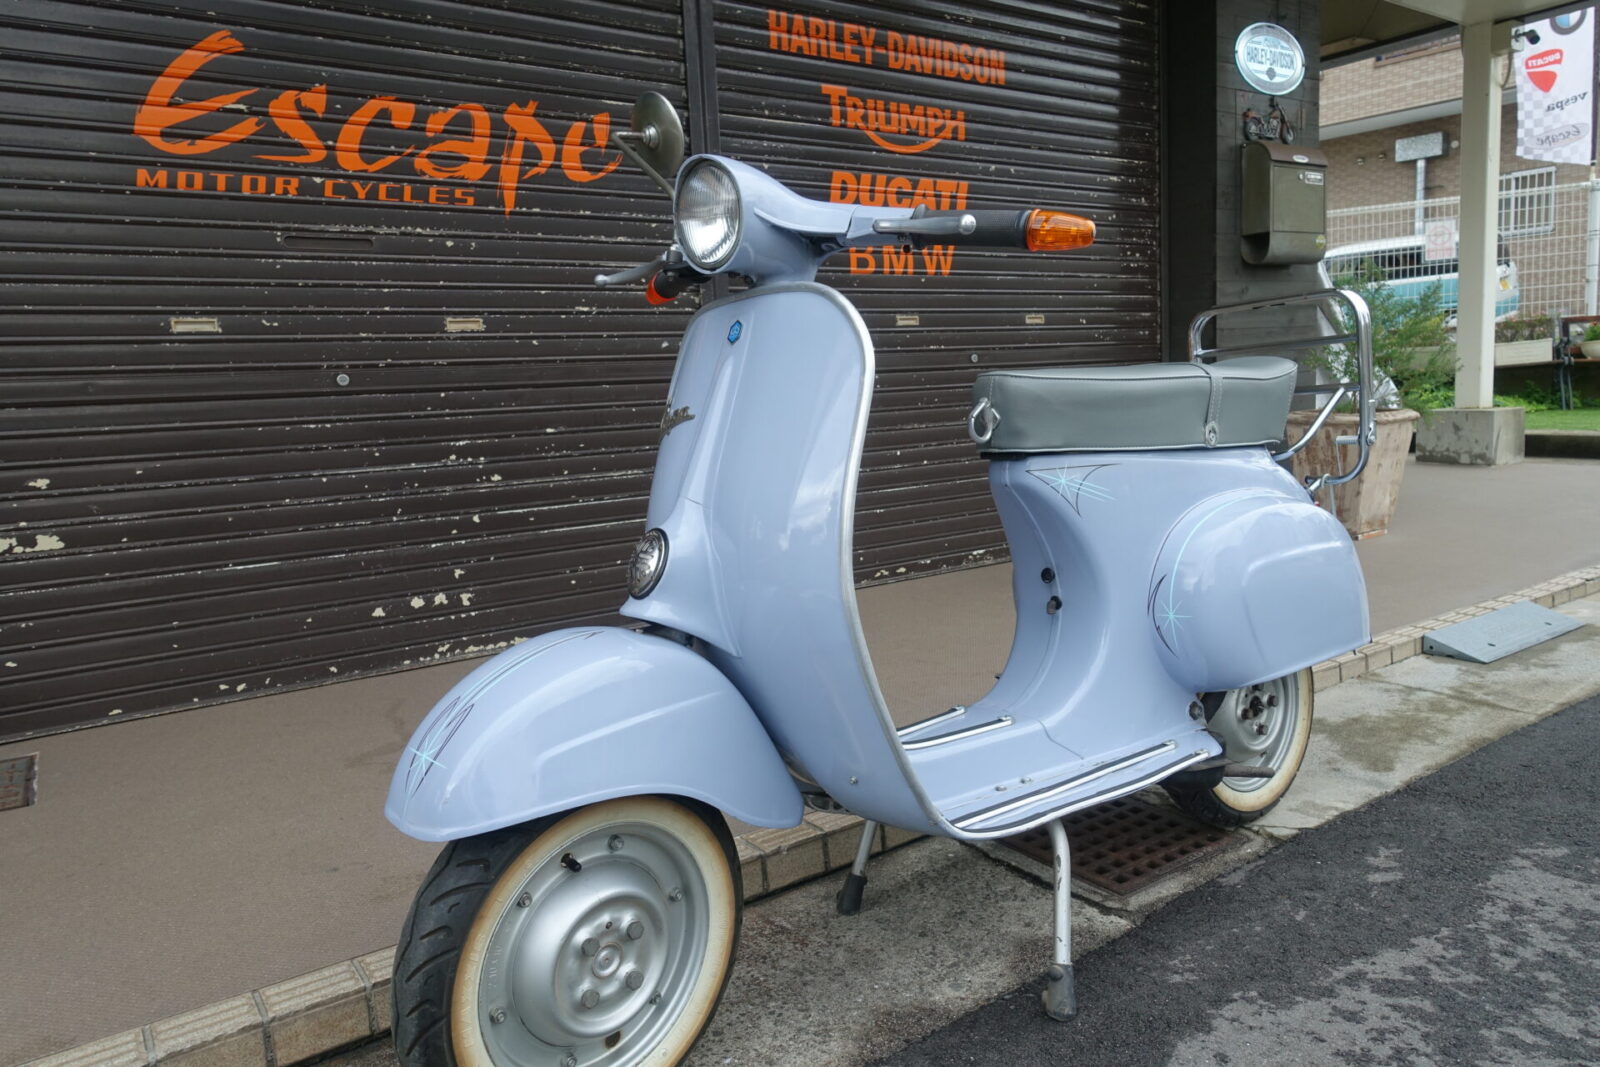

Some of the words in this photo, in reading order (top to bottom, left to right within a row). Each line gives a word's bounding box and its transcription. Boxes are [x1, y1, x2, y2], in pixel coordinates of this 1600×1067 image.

[767, 9, 1006, 85] HARLEY-DAVIDSON
[133, 29, 623, 218] Escape
[135, 168, 299, 196] MOTOR
[323, 178, 477, 207] CYCLES
[829, 170, 969, 211] DUCATI
[849, 244, 956, 277] BMW
